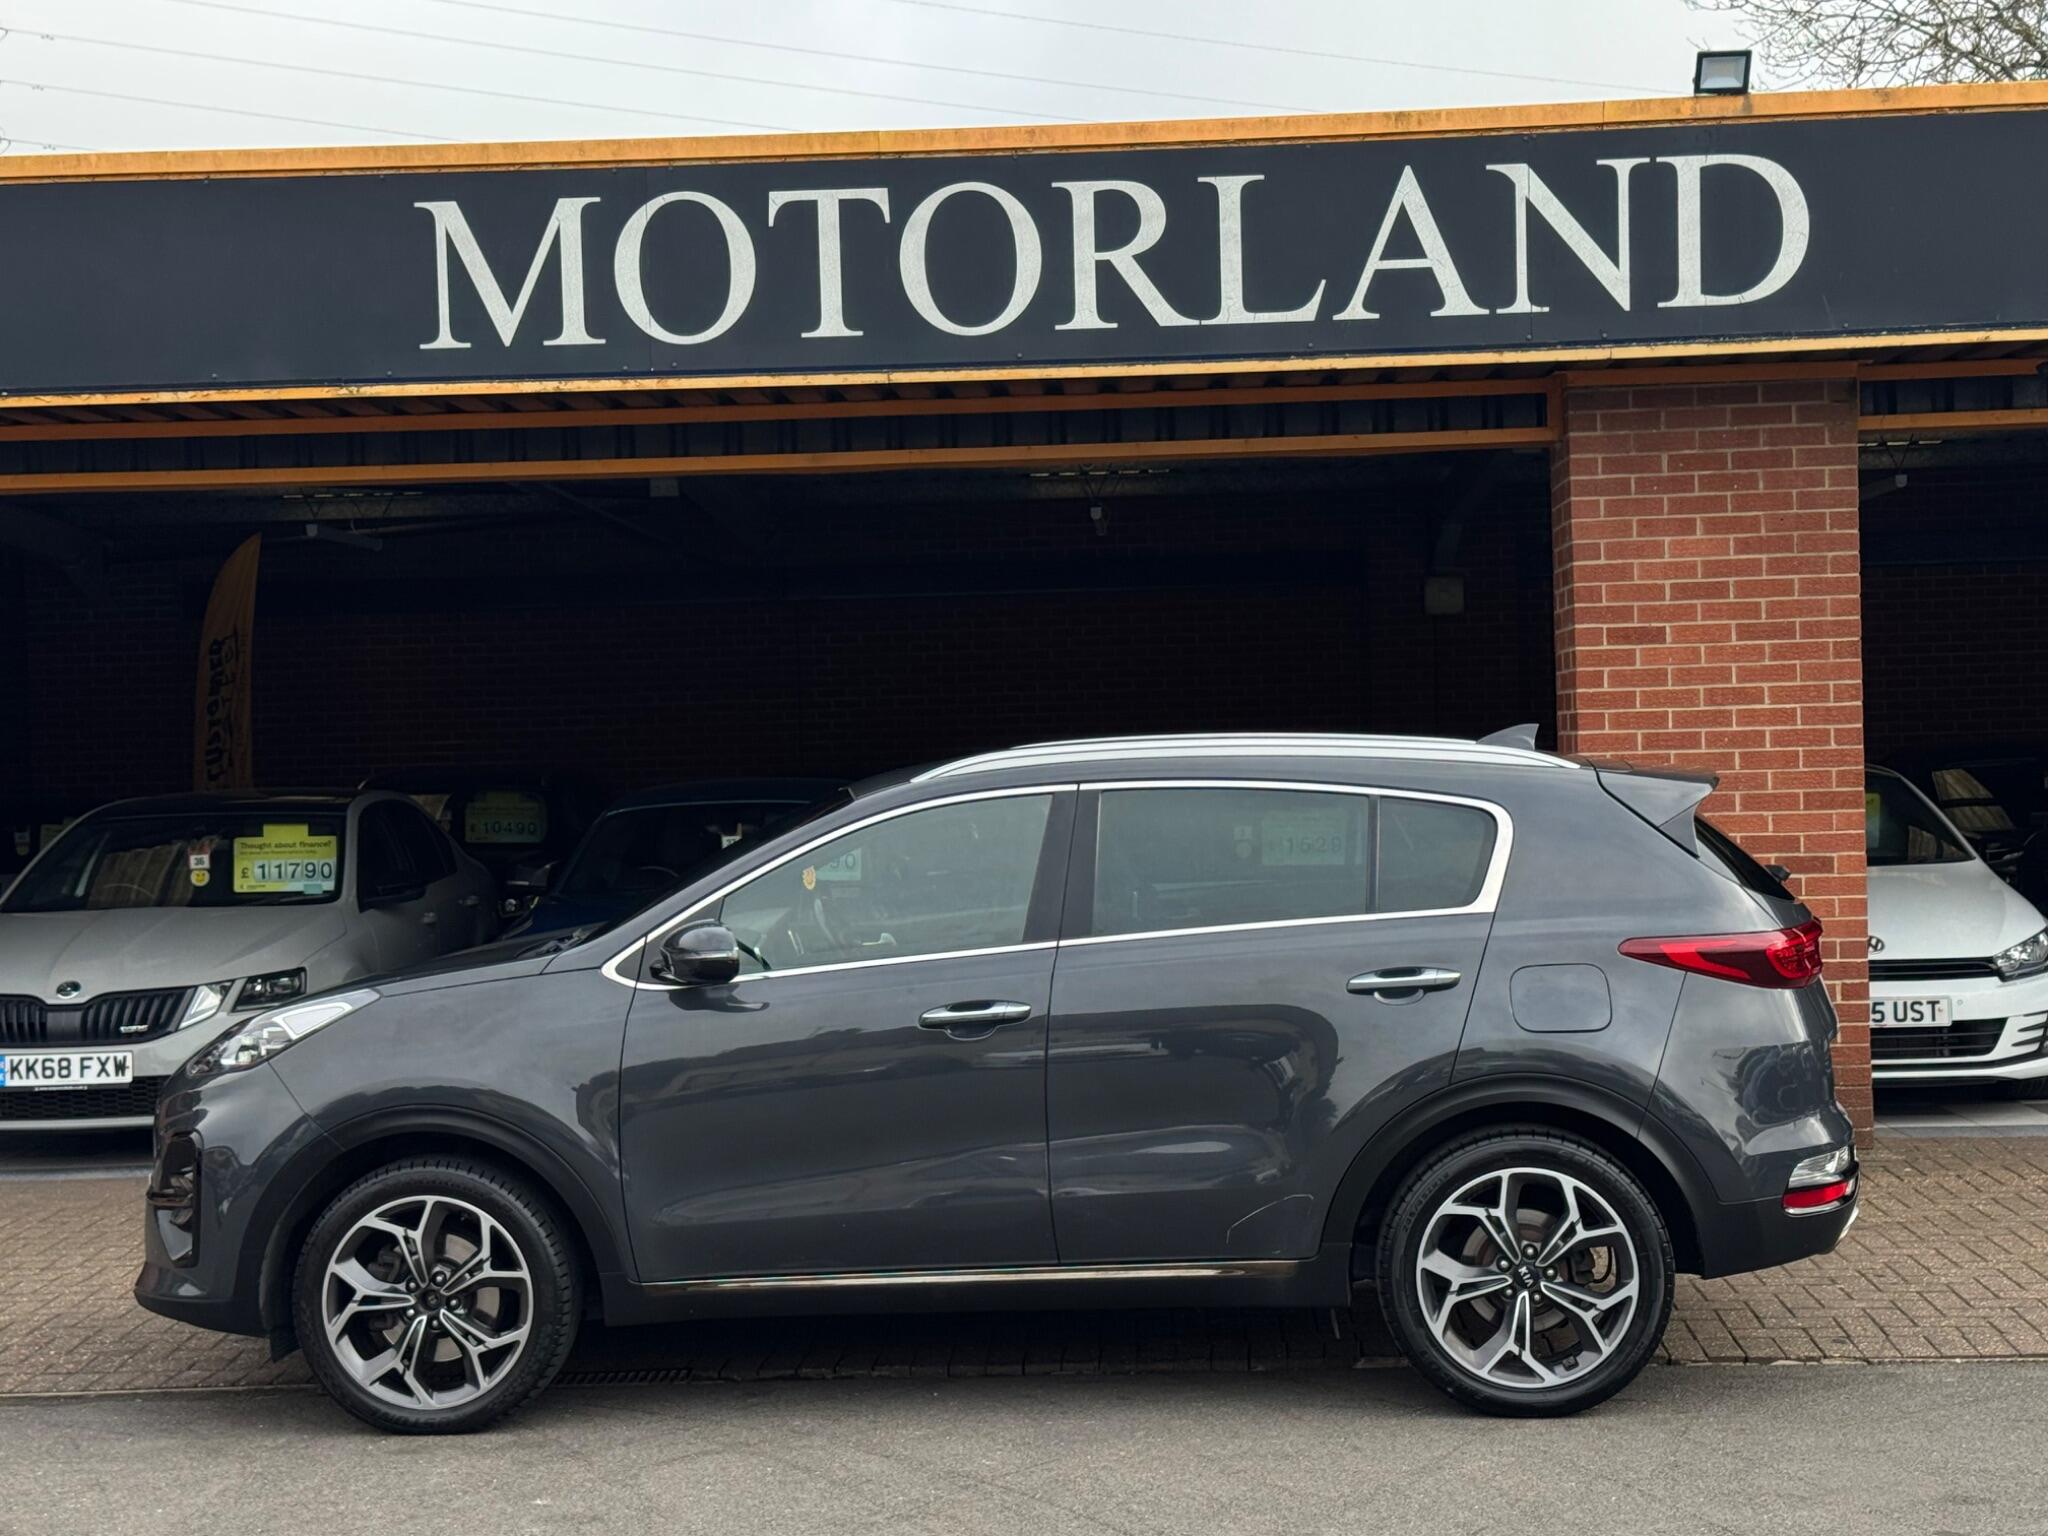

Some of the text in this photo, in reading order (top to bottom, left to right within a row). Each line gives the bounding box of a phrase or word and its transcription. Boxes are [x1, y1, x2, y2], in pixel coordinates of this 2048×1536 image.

[414, 154, 1809, 349] MOTORLAND
[274, 841, 297, 849] about
[257, 862, 333, 880] 11790
[1871, 1000, 1940, 1023] 5 UST
[10, 1055, 128, 1080] KK68 FXW
[1518, 1266, 1534, 1288] KIA
